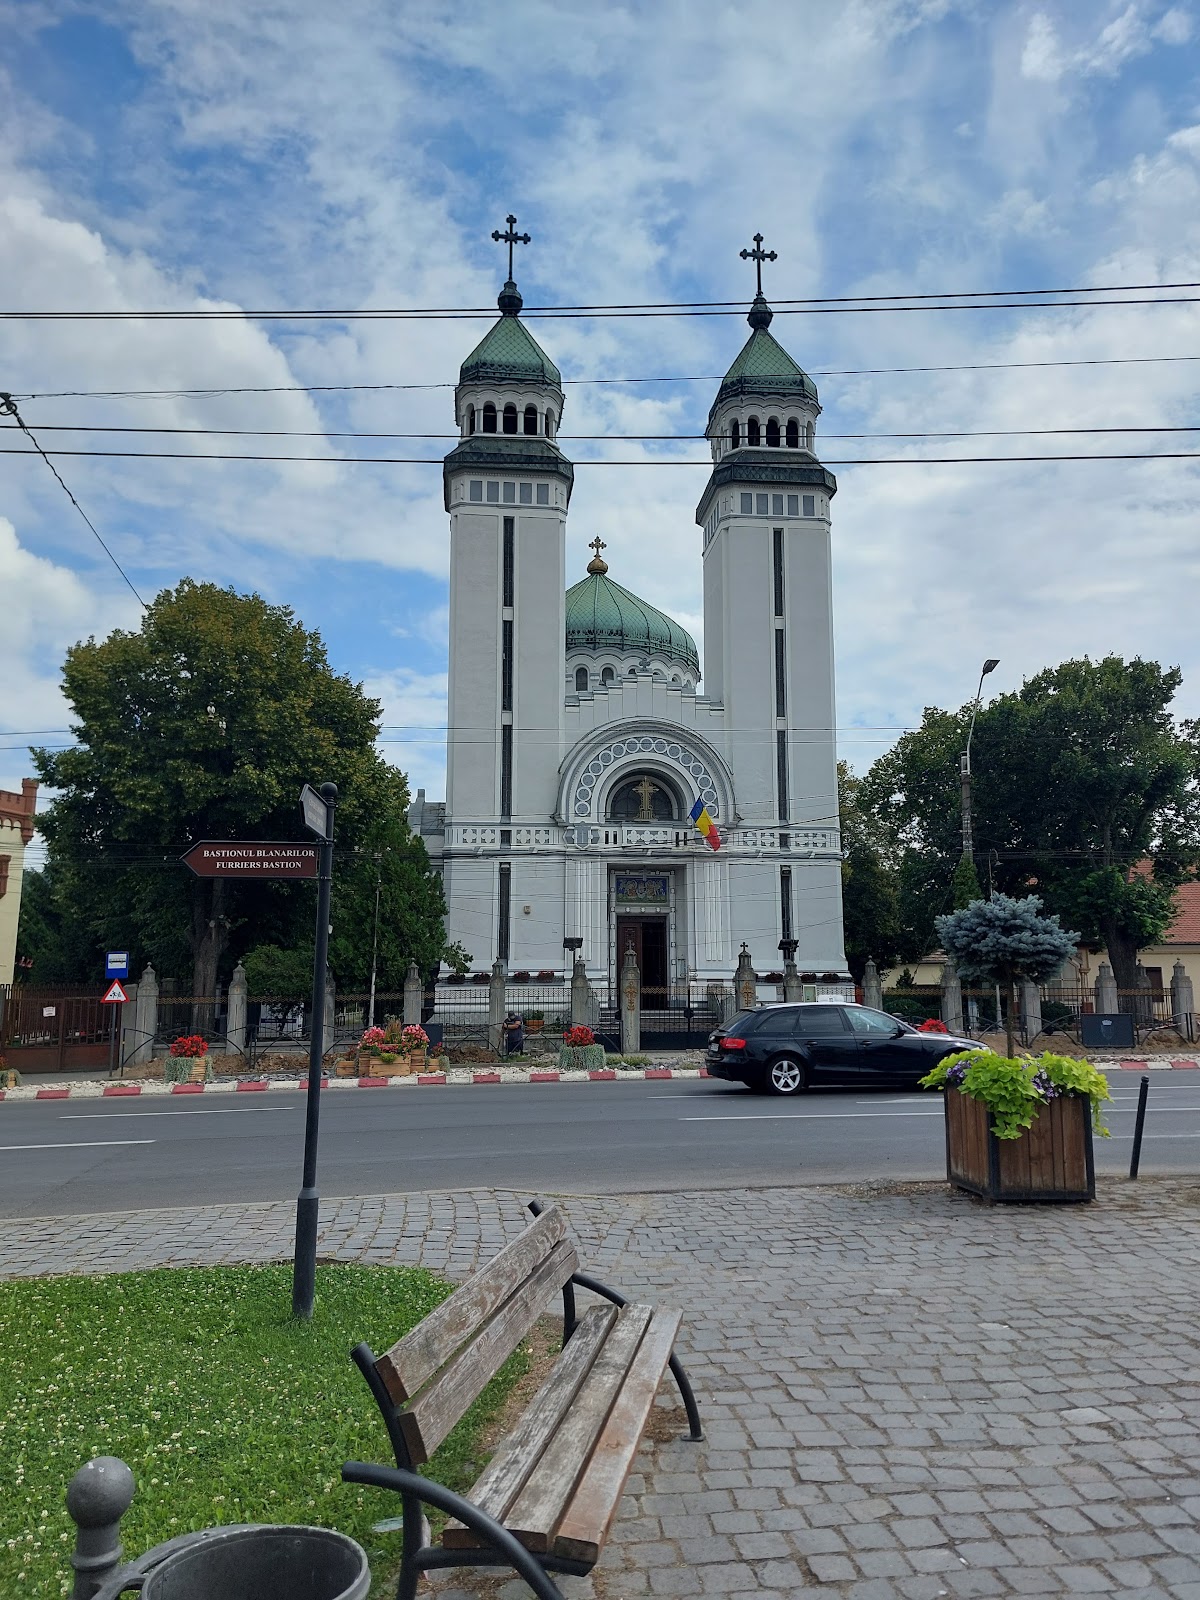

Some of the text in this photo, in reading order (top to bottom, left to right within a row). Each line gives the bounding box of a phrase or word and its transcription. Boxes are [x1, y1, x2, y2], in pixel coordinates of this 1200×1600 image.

[203, 849, 315, 857] BASTIONUL BLANARILOR
[216, 861, 302, 869] FURRIERS BASTION
